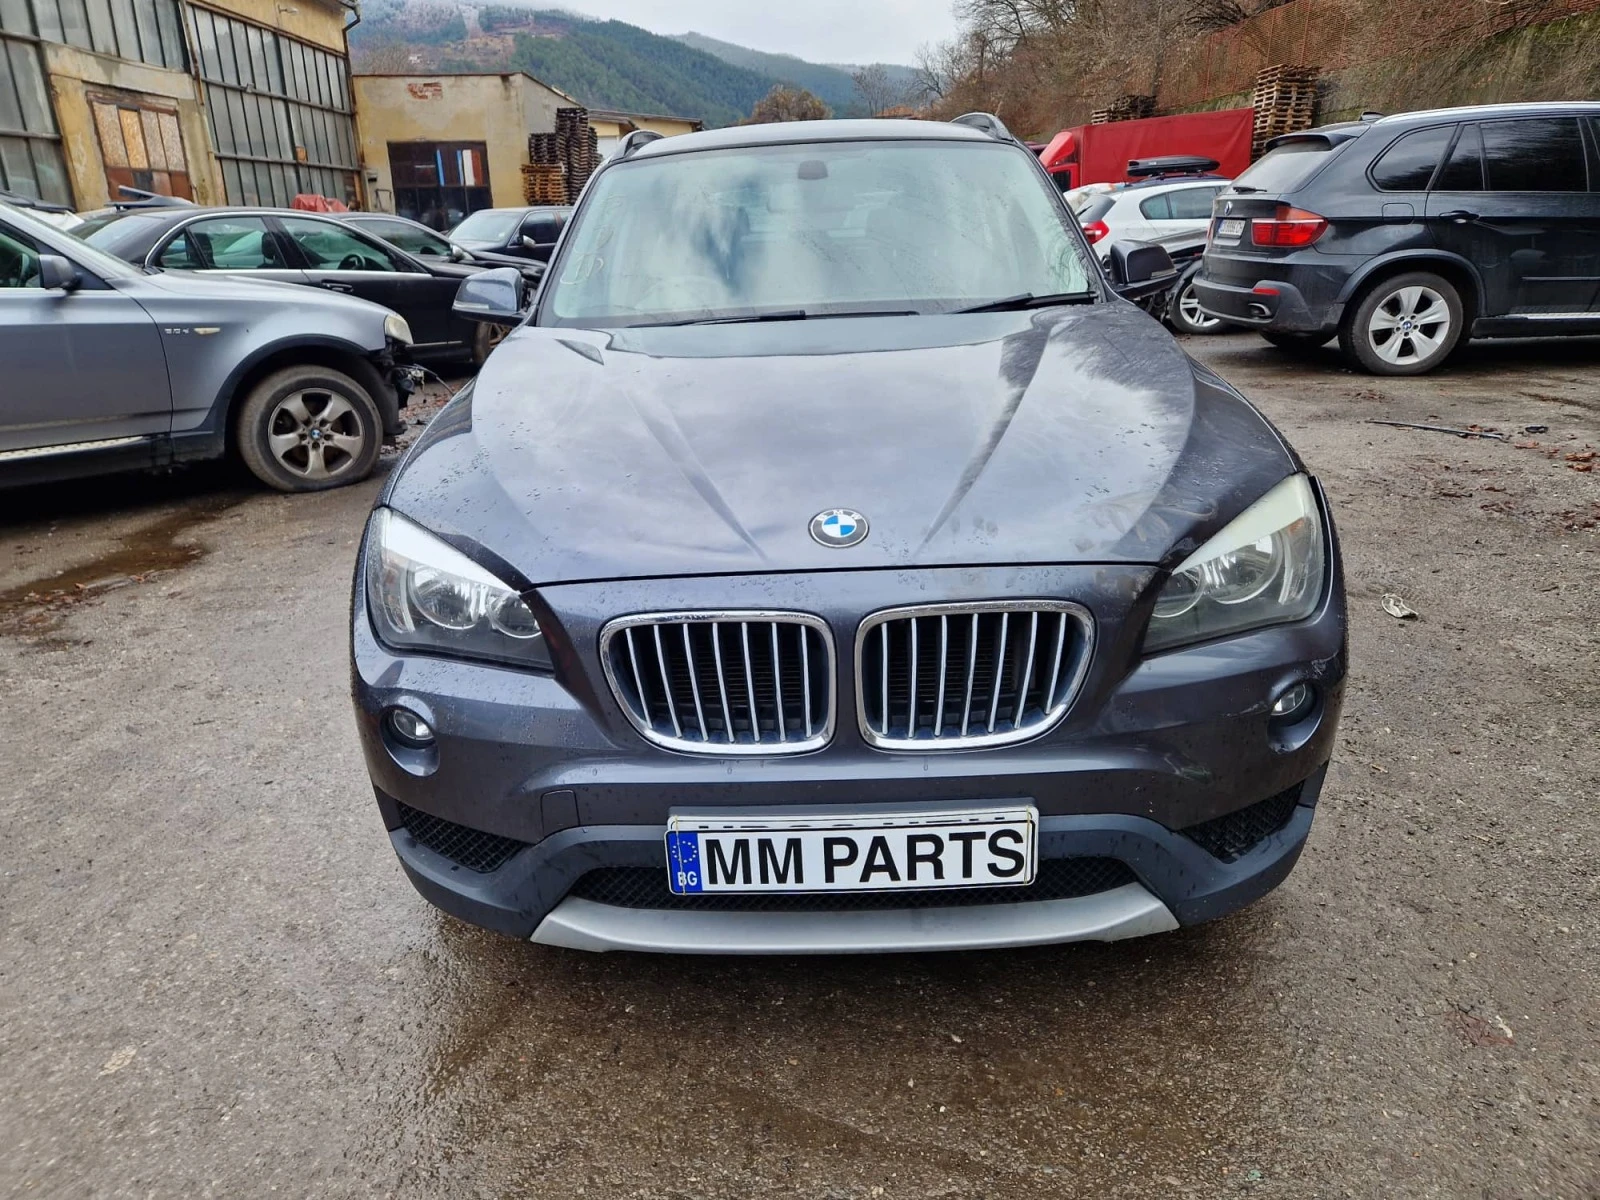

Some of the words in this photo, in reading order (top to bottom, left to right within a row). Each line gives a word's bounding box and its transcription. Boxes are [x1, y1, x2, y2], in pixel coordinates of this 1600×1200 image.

[816, 509, 862, 521] BMW
[705, 838, 804, 885] MM
[823, 829, 1025, 884] PARTS
[677, 871, 698, 887] BG
